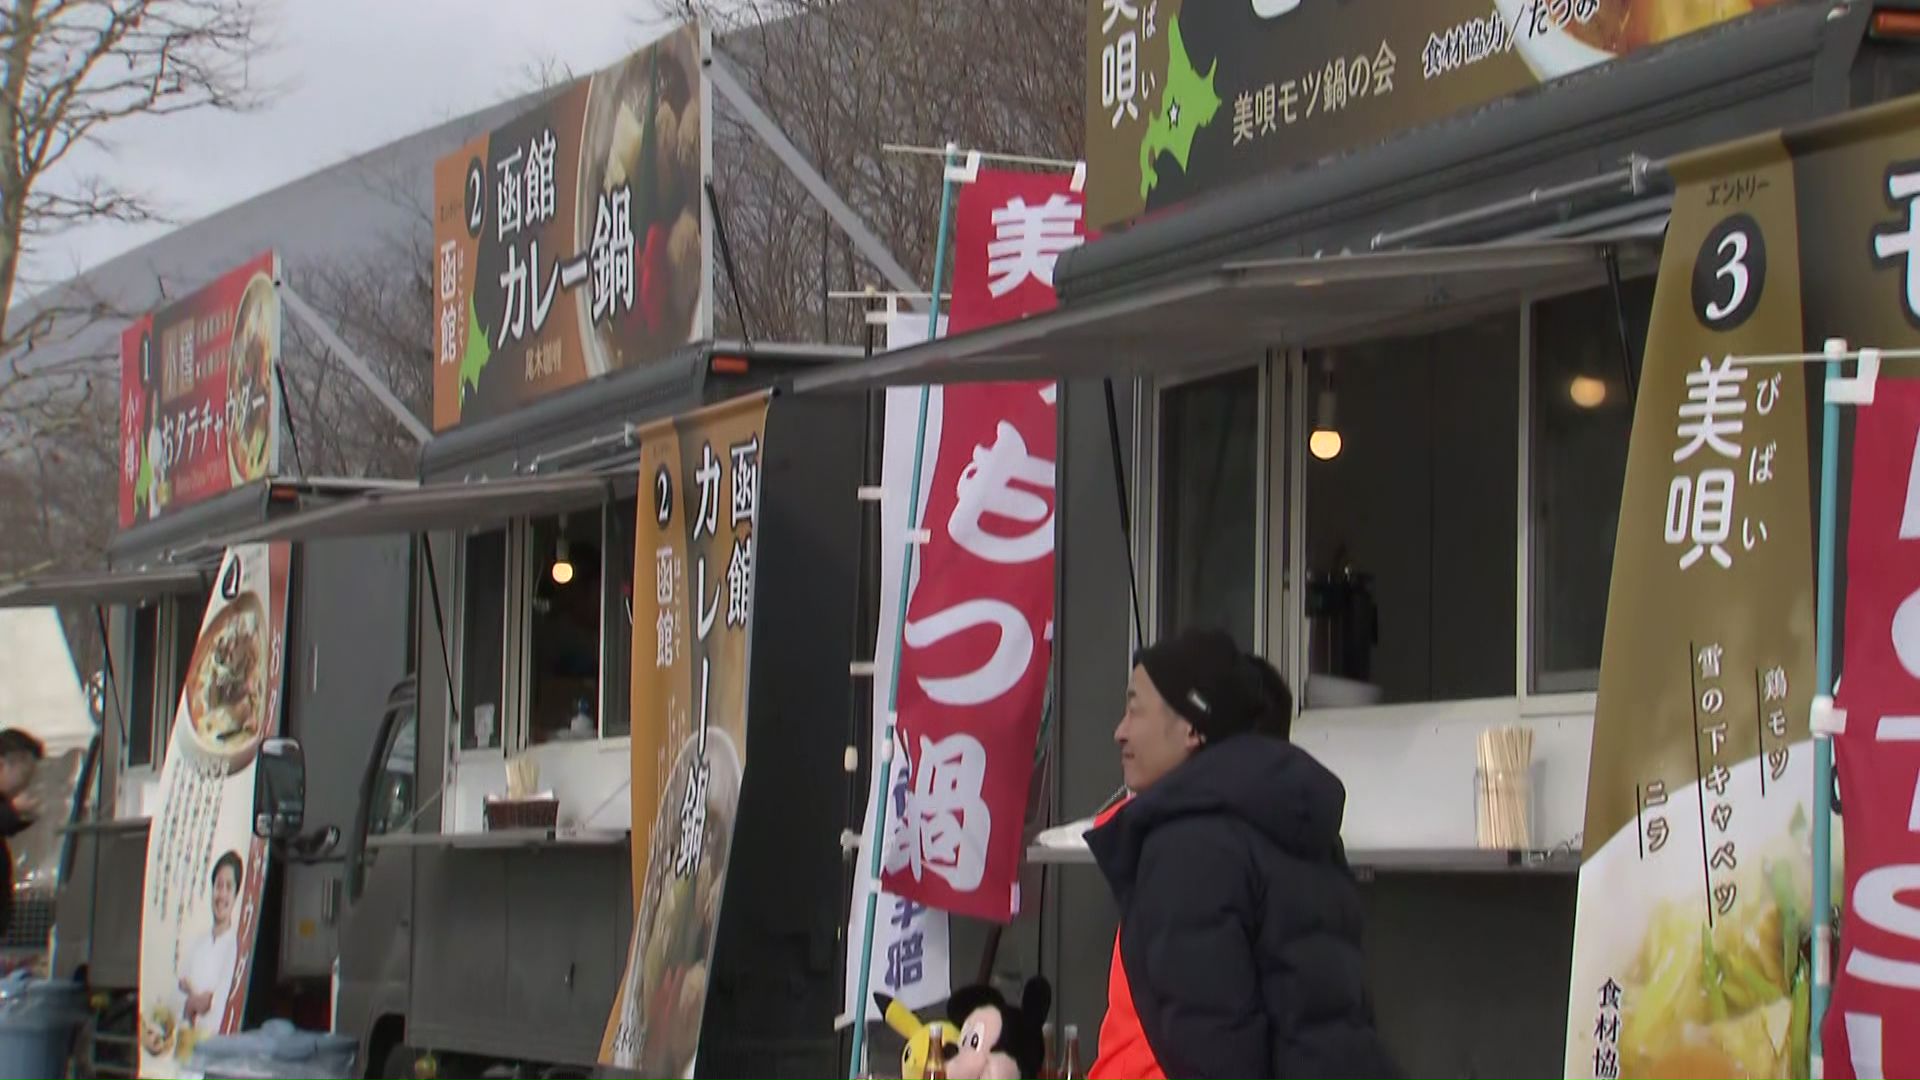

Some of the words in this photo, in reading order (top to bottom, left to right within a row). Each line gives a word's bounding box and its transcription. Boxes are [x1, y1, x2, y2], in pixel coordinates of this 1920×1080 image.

[1232, 38, 1398, 147] 美唄モツ鍋の会
[469, 167, 483, 230] 2
[495, 128, 557, 243] 函館
[1706, 171, 1771, 207] エントリー
[440, 239, 457, 366] 函館
[496, 182, 635, 351] カレー鍋
[1704, 229, 1749, 321] 3
[656, 468, 671, 524] 2
[1662, 352, 1749, 572] 美唄
[1742, 370, 1783, 552] びばい
[726, 430, 760, 628] 函館
[882, 192, 1085, 893] 美もつ鍋
[655, 545, 675, 669] 函館
[674, 443, 722, 880] カレー鍋
[1696, 642, 1738, 914] 雪の下キャベツ
[1762, 664, 1789, 780] 鶏モツ
[1642, 780, 1671, 853] ニラ
